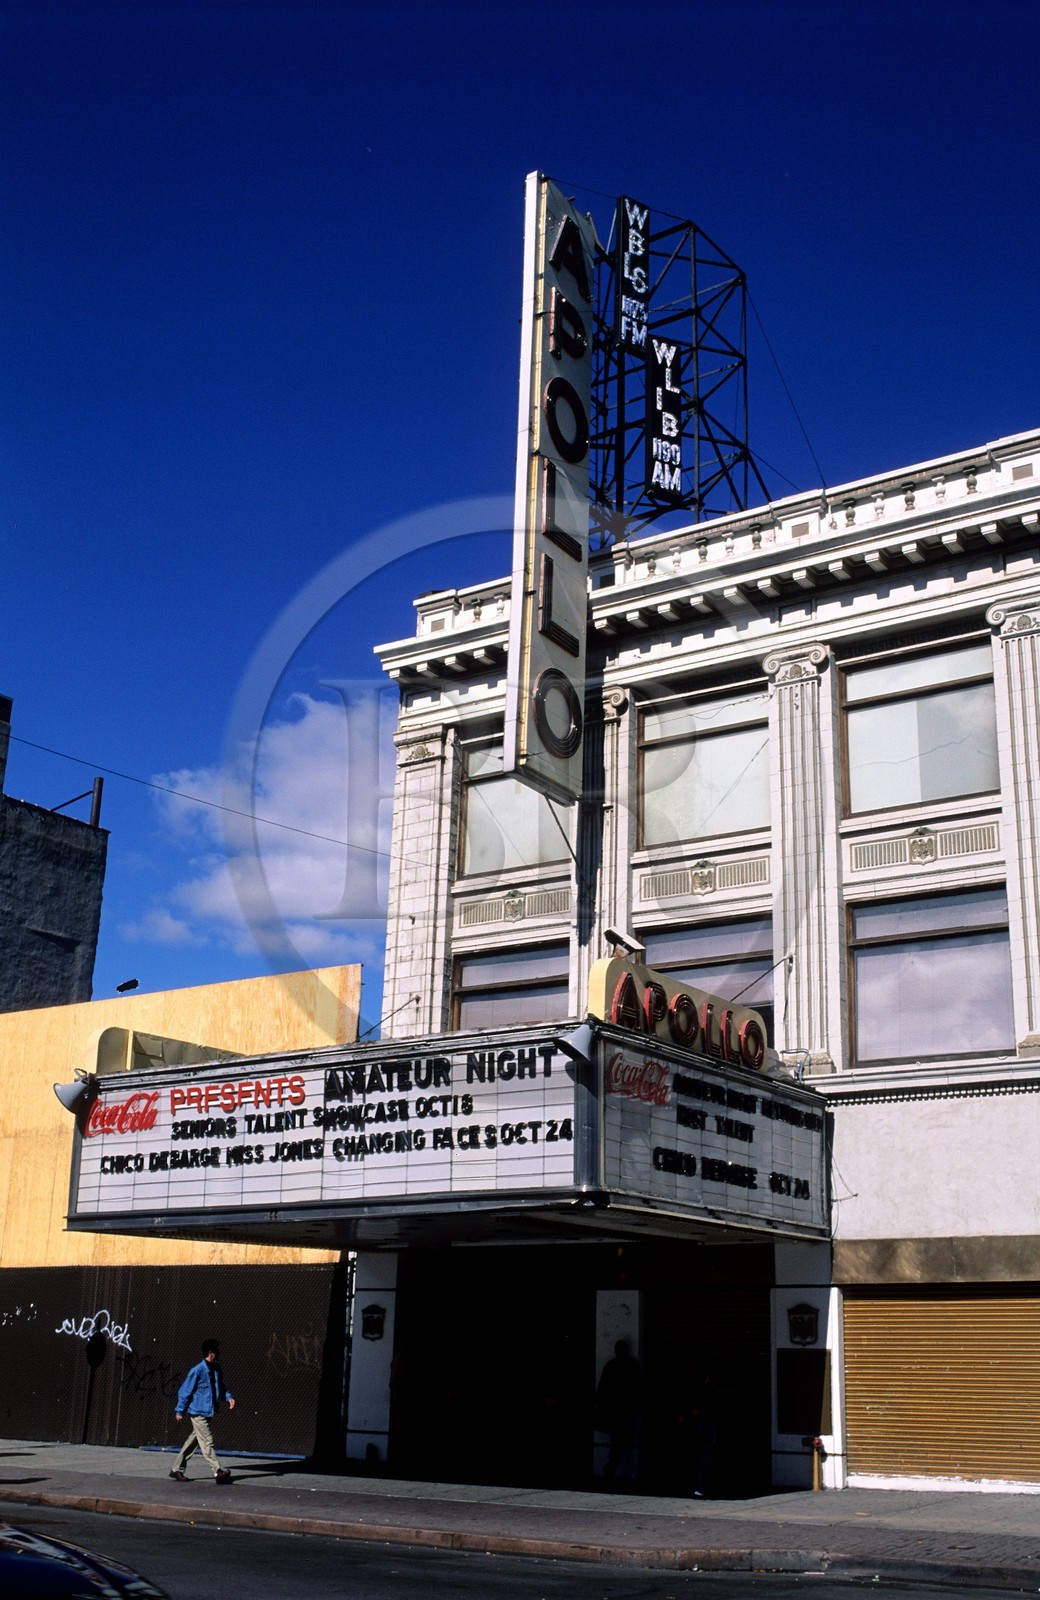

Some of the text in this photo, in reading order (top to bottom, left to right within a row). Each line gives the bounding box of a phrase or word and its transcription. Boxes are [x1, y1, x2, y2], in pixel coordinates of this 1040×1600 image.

[621, 315, 648, 347] FM
[532, 213, 592, 759] APOLLO
[652, 461, 681, 491] AM
[611, 971, 765, 1070] APOLLO
[170, 1075, 305, 1116] PRESENTS
[324, 1047, 557, 1102] AMATEUR NIGHT
[244, 1108, 307, 1134] TALENT
[269, 1138, 324, 1163] JONES
[333, 1128, 426, 1162] CHANGING
[546, 1118, 573, 1142] 24
